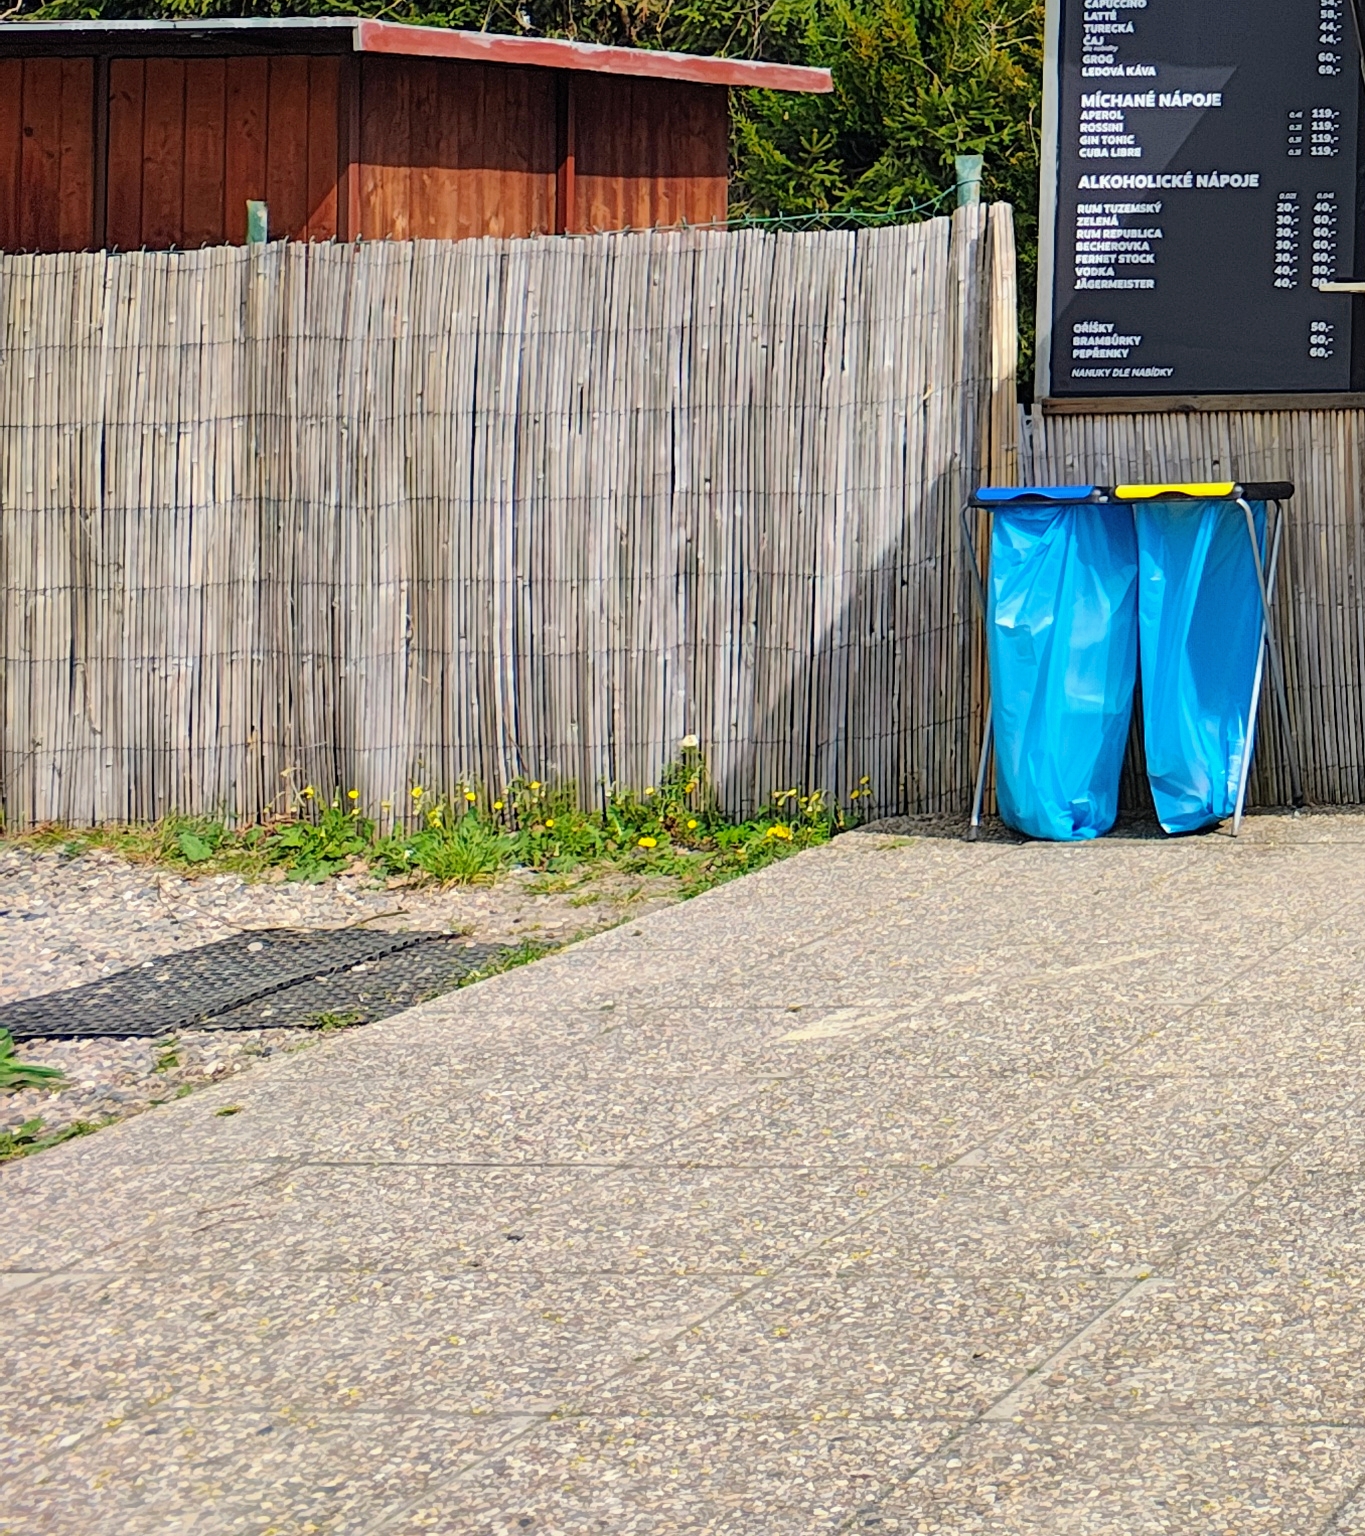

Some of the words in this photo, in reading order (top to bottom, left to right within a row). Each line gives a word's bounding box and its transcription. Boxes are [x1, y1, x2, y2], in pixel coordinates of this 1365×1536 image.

[1084, 0, 1147, 8] CAPUCCINO
[1084, 9, 1116, 20] LATTÉ
[1083, 21, 1134, 33] TURECKÁ
[1083, 34, 1104, 45] ČAJ
[1083, 54, 1114, 64] GROG
[1082, 64, 1124, 76] LEDOVÁ
[1126, 64, 1156, 76] KÁVA
[1081, 90, 1155, 108] MÍCHANÉ
[1159, 90, 1221, 107] NÁPOJE
[1080, 110, 1124, 120] APEROL
[1080, 123, 1123, 132] ROSSINI
[1080, 136, 1099, 145] GIN
[1101, 135, 1135, 144] TONIC
[1079, 148, 1108, 157] CUBA
[1111, 148, 1141, 157] LIBRE
[1078, 171, 1192, 188] ALKOHOLICKÉ
[1196, 171, 1259, 188] NÁPOJE
[1077, 204, 1102, 213] RUM
[1104, 201, 1161, 213] TUZEMSKÝ
[1077, 214, 1118, 226] ZELENÁ
[1077, 229, 1101, 238] RUM
[1103, 229, 1162, 238] REPUBLICA
[1076, 242, 1149, 251] BECHEROVKA
[1076, 255, 1116, 264] FERNET
[1118, 254, 1155, 263] STOCK
[1075, 267, 1114, 276] VODKA
[1074, 278, 1154, 289] JÄGERMEISTER
[1073, 321, 1114, 333] OŘÍŠKY
[1072, 368, 1111, 377] NANUKY
[1112, 368, 1130, 377] DLE
[1132, 366, 1173, 377] NABÍDKY
